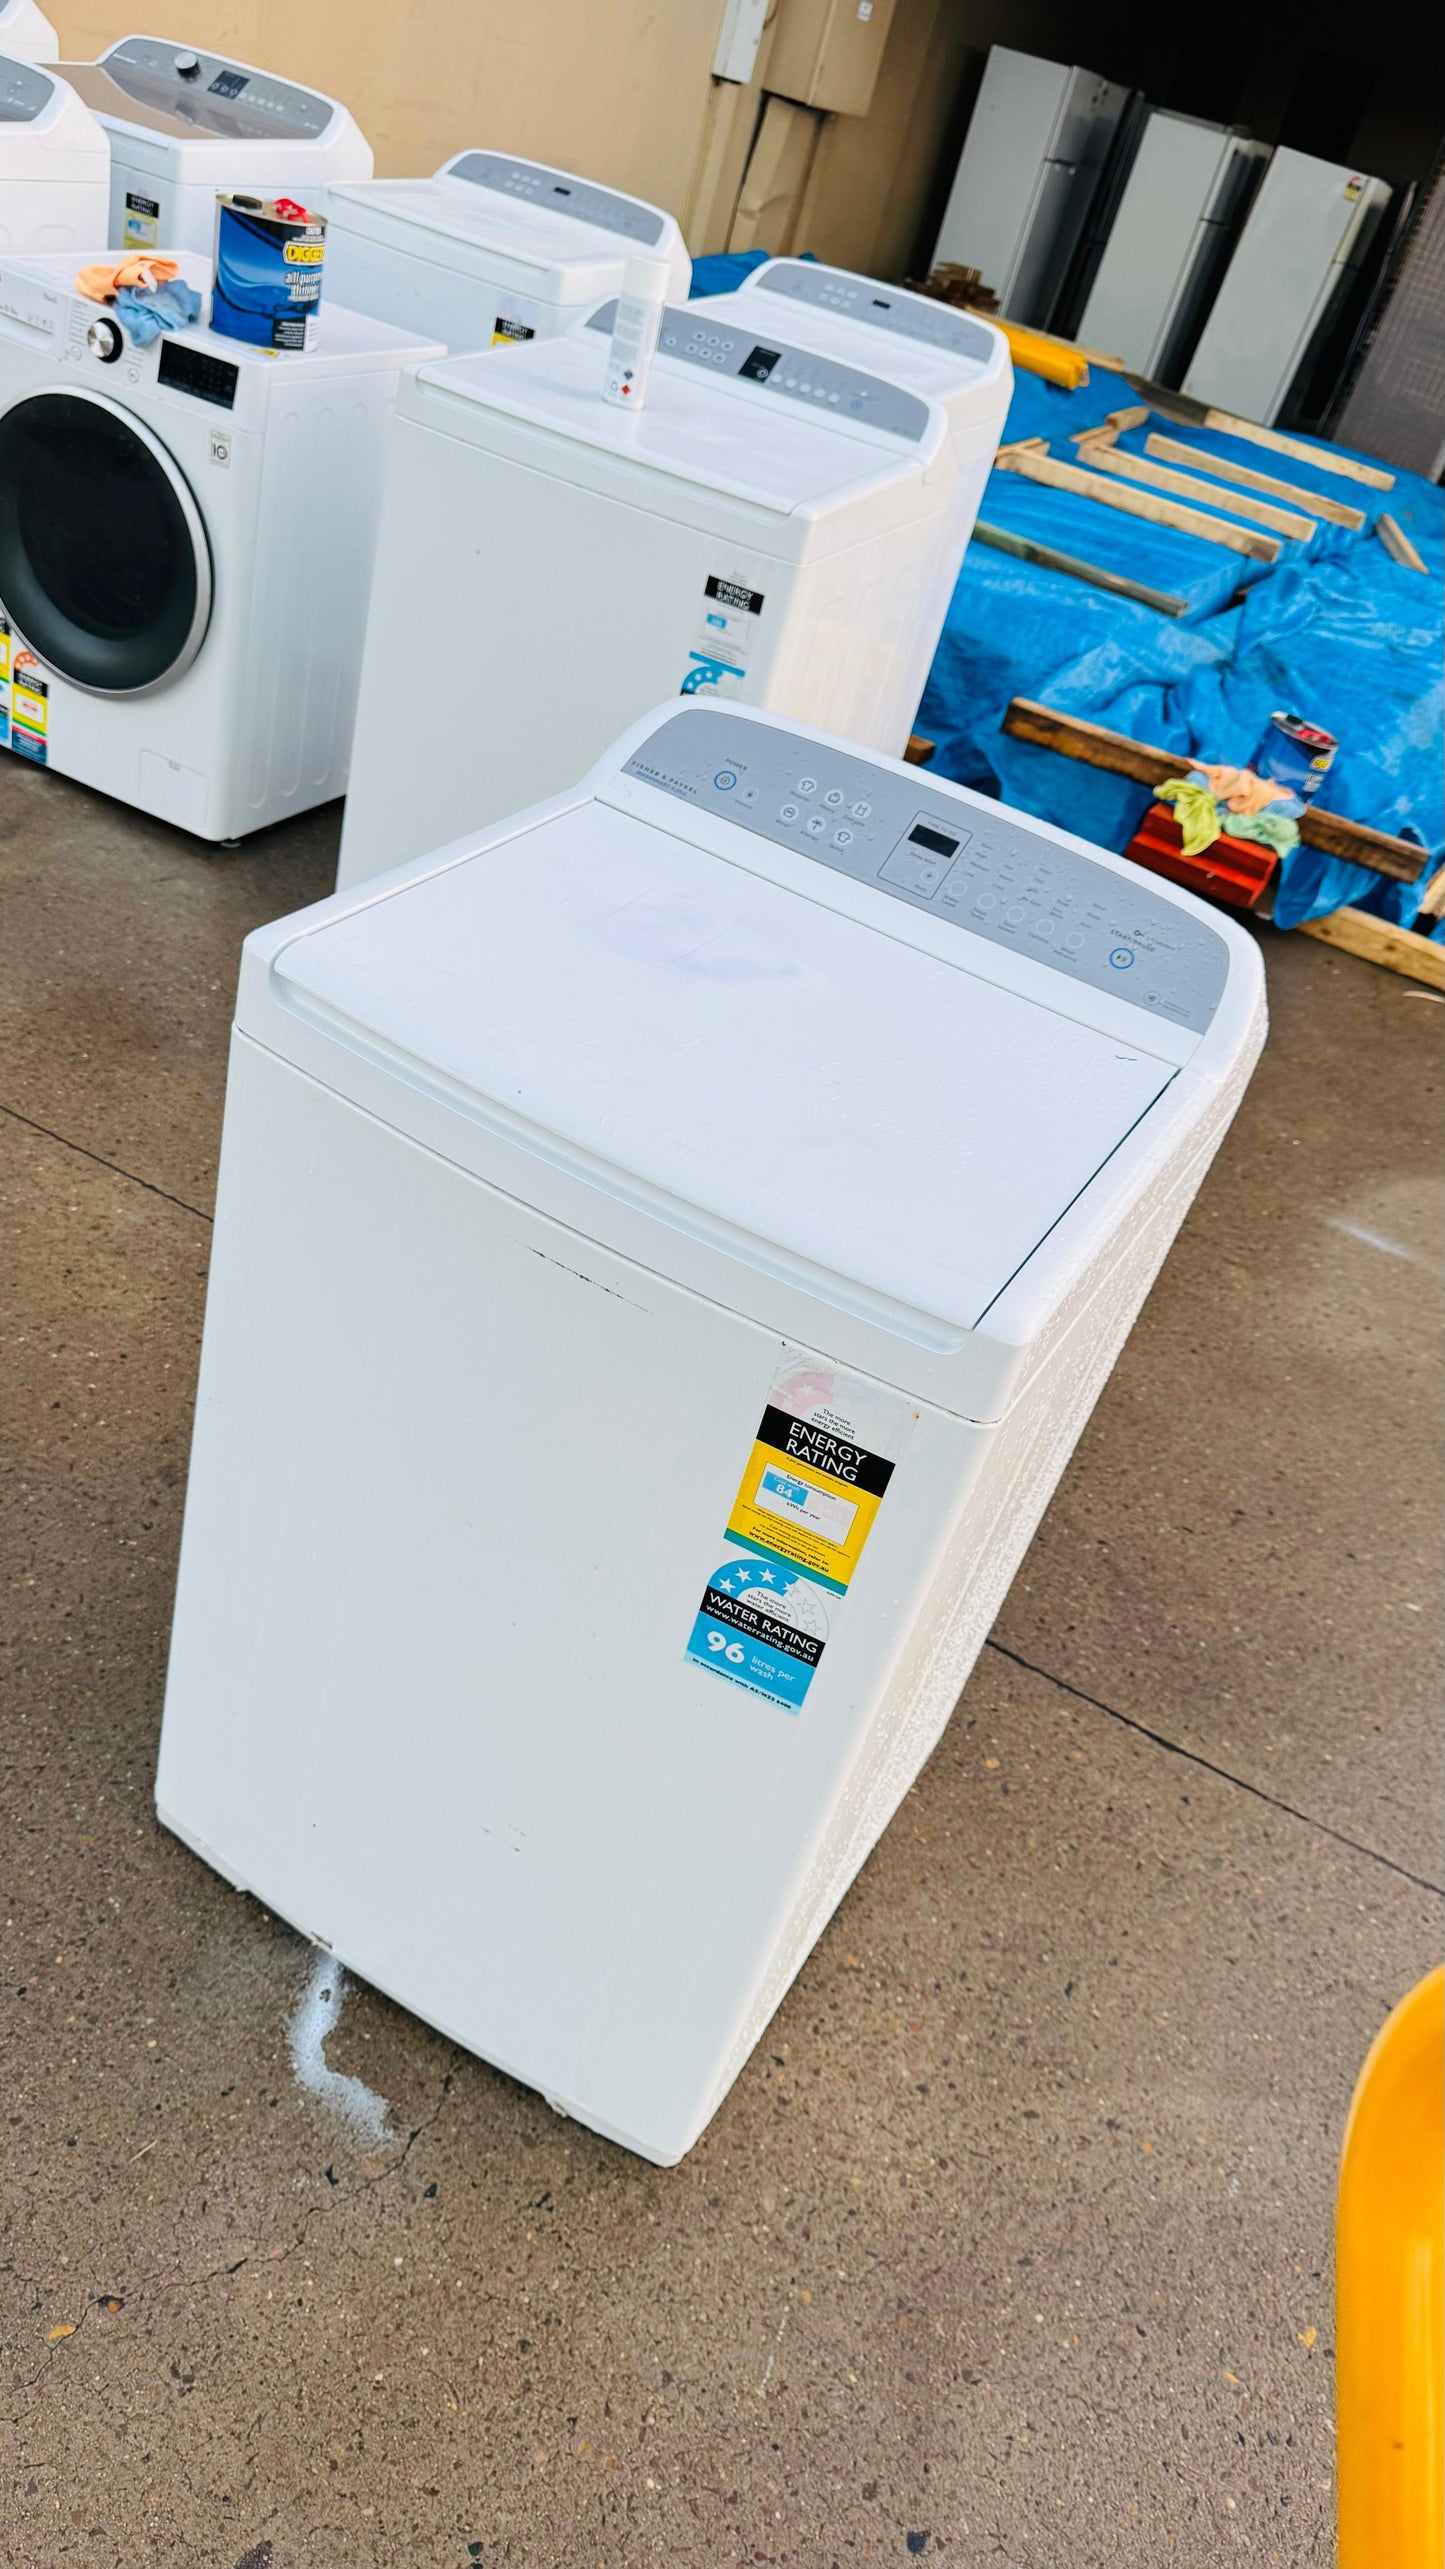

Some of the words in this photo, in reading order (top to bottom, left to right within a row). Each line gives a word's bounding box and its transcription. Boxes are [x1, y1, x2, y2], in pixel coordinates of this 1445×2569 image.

[716, 591, 750, 611] RATING
[717, 581, 754, 601] ENERGY
[631, 761, 660, 777] FISHER
[669, 778, 697, 795] PAYKEL
[811, 1417, 830, 1429] energy
[831, 1426, 854, 1440] efficient
[814, 1412, 827, 1421] stars
[829, 1418, 839, 1427] the
[840, 1424, 856, 1434] more
[823, 1409, 834, 1418] The
[835, 1416, 851, 1425] more
[789, 1421, 867, 1466] ENERGY
[786, 1438, 858, 1482] RATING
[776, 1484, 793, 1498] 84
[787, 1474, 803, 1486] Energy
[804, 1483, 837, 1501] consumption
[800, 1508, 809, 1516] per
[809, 1513, 821, 1521] year
[749, 1531, 830, 1573] www.energyrating.gov.au
[747, 1593, 762, 1603] stars
[763, 1601, 774, 1610] the
[774, 1607, 791, 1618] more
[747, 1599, 764, 1610] water
[765, 1607, 789, 1623] efficient
[756, 1591, 768, 1600] The
[770, 1599, 786, 1609] more
[706, 1605, 814, 1662] www.waterrating.gov.au
[710, 1592, 758, 1625] WATER
[762, 1619, 818, 1654] RATING
[707, 1631, 745, 1664] 96
[700, 1662, 733, 1681] accordance
[734, 1678, 749, 1689] with
[750, 1664, 774, 1681] wash
[752, 1656, 776, 1673] litres
[778, 1670, 796, 1681] per
